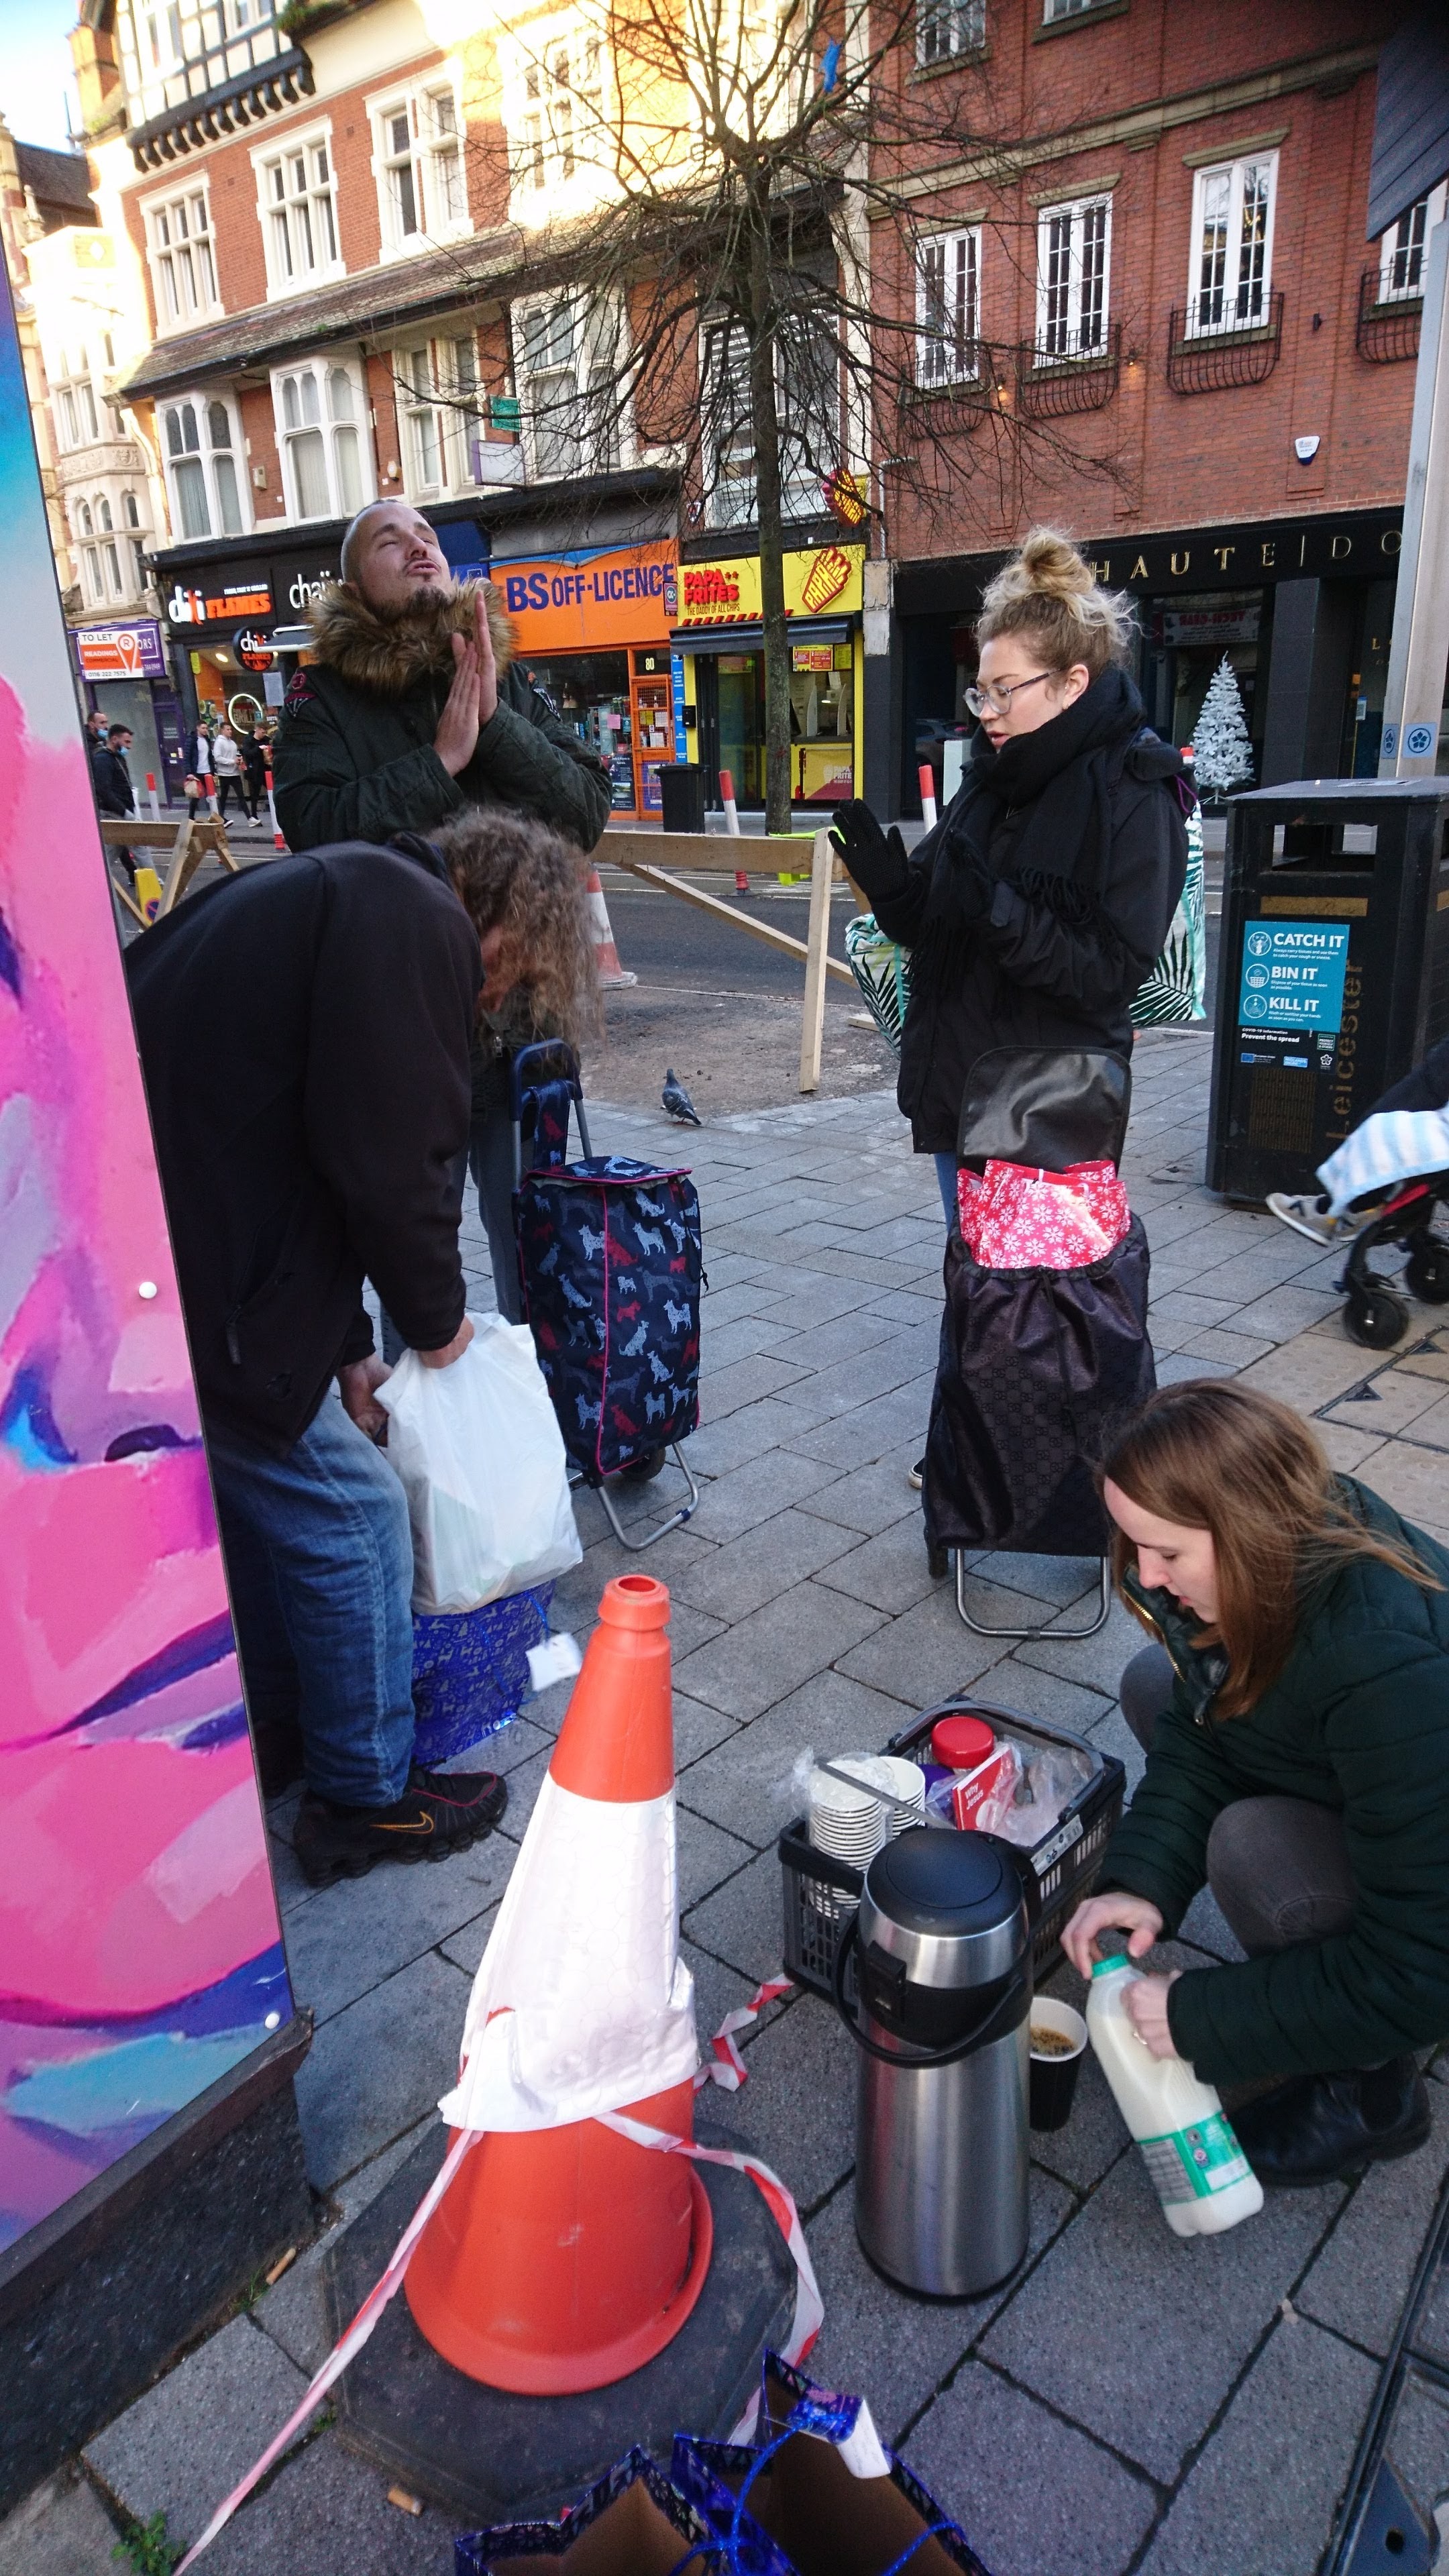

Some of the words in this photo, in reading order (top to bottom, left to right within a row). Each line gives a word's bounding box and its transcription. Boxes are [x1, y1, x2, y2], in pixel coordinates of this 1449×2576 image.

[1091, 543, 1275, 582] HAUTE
[684, 569, 726, 588] PAPA
[805, 560, 839, 609] PAPA
[506, 573, 549, 612] BS
[684, 584, 739, 606] FRITES
[205, 593, 271, 619] FLAMES
[687, 607, 695, 615] THE
[696, 606, 711, 614] DADDY
[711, 605, 717, 613] OF
[718, 604, 726, 612] ALL
[727, 603, 740, 612] CHIPS
[123, 639, 130, 647] R
[645, 657, 655, 671] 80
[1274, 933, 1326, 947] CATCH
[1329, 935, 1345, 948] IT
[1271, 966, 1299, 979] BIN
[1302, 967, 1318, 980] IT
[1269, 997, 1301, 1010] KILL
[1304, 999, 1320, 1012] IT
[1326, 959, 1362, 1138] Leicester
[965, 1782, 979, 1799] Why
[967, 1789, 983, 1810] Jesus
